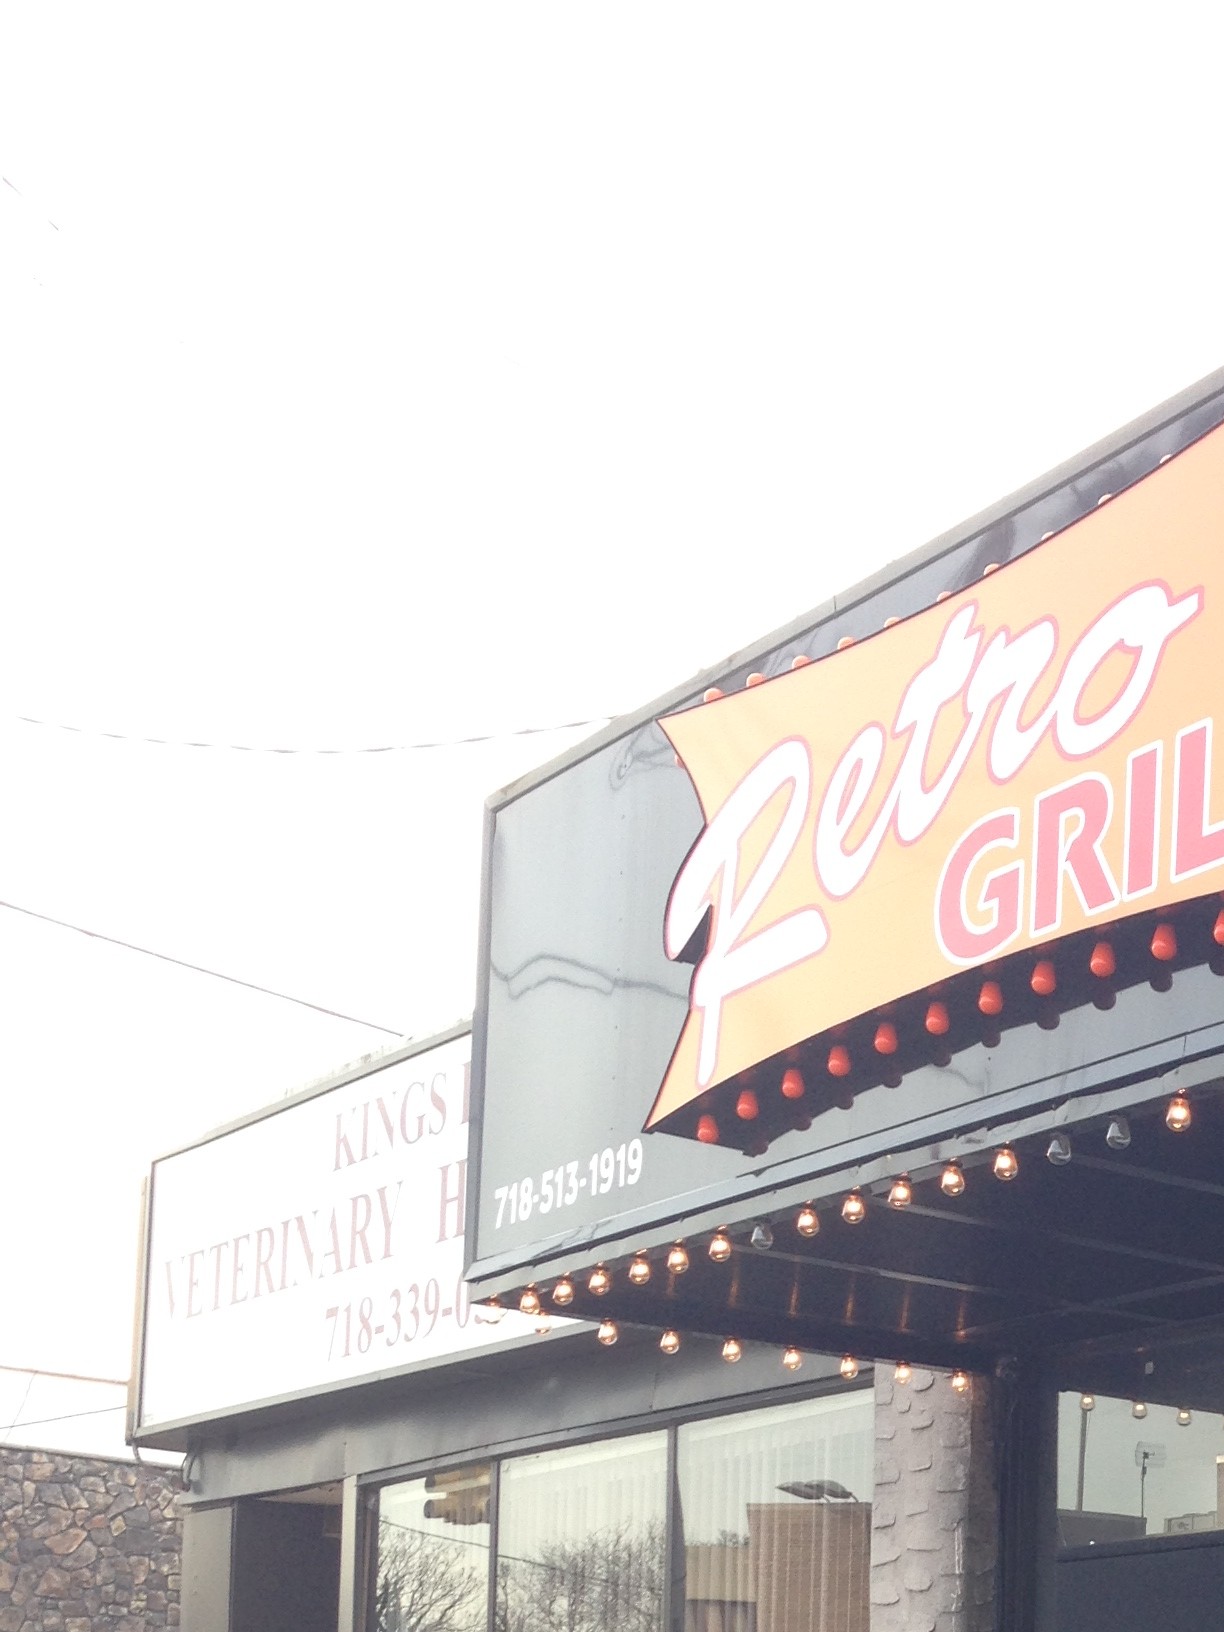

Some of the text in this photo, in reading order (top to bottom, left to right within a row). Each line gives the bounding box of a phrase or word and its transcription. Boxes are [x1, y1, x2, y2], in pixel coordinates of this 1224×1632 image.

[663, 577, 1205, 1087] Retro
[333, 1072, 447, 1172] KINGS
[494, 1138, 643, 1230] 718-513-1919
[165, 1180, 404, 1320] VETERINARY
